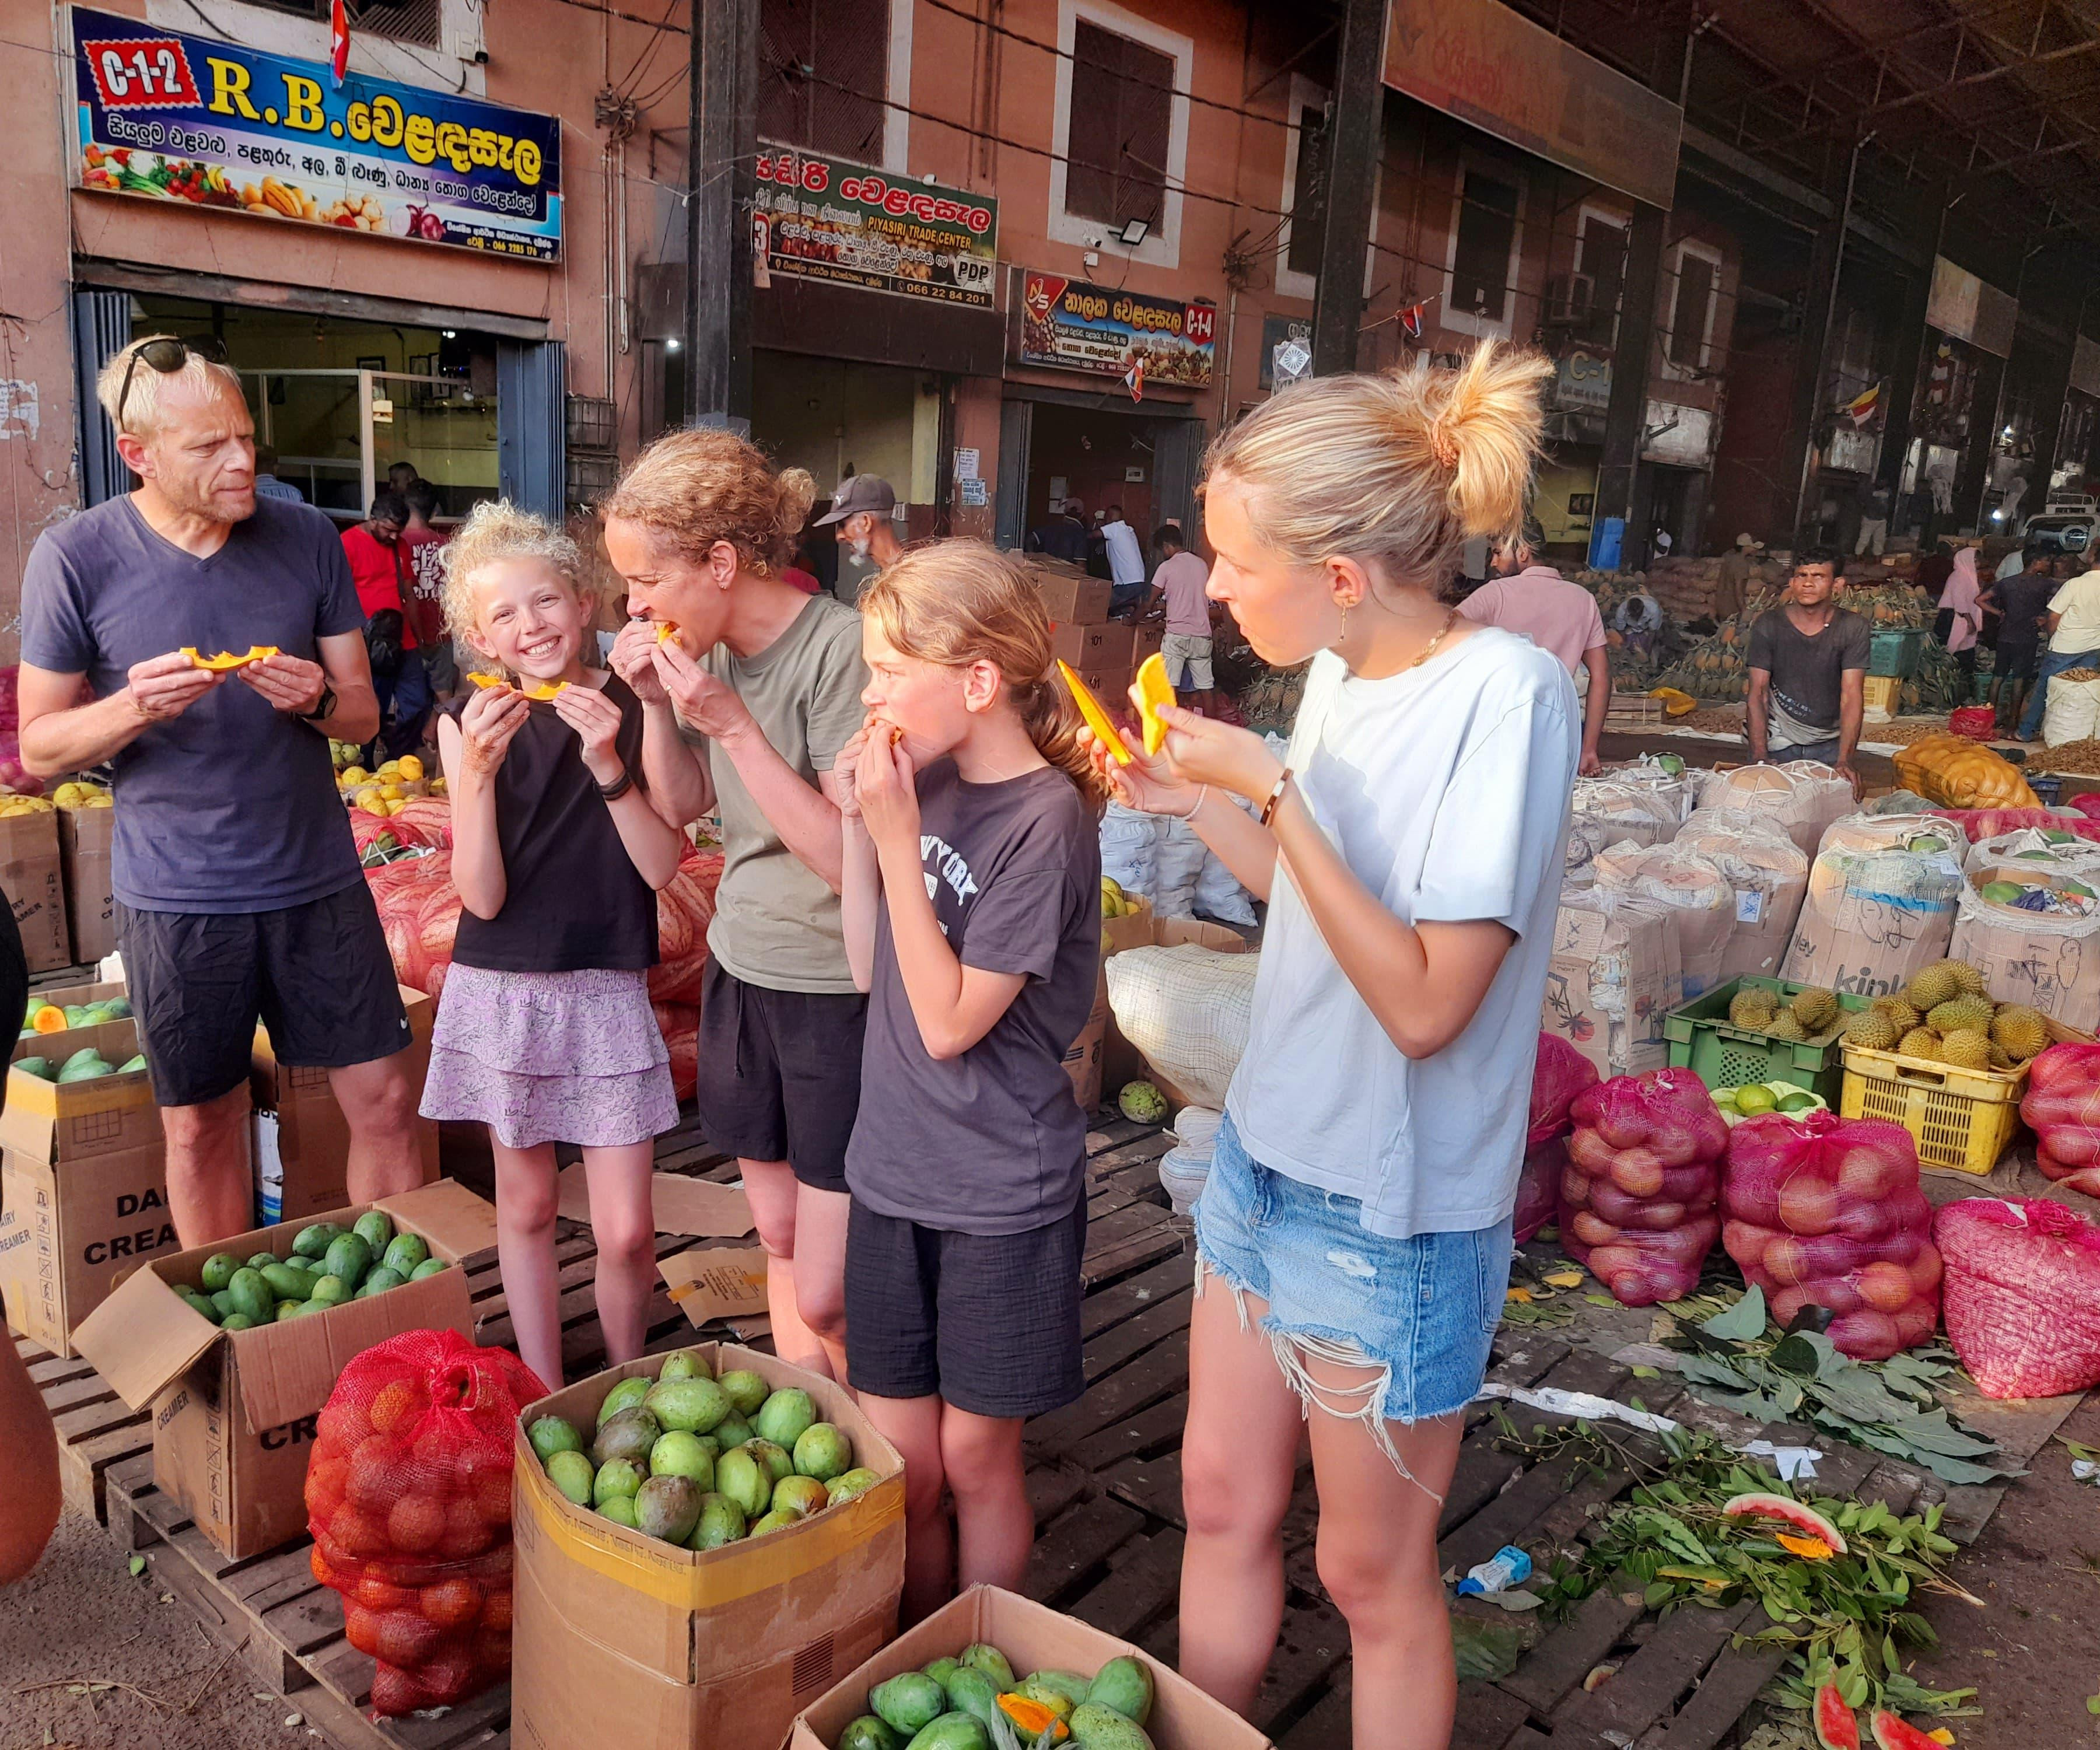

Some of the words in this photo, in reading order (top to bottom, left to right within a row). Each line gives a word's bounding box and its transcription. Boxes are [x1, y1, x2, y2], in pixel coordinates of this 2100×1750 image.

[101, 49, 182, 96] C-1-2
[109, 114, 164, 146] සියලුම
[435, 181, 468, 199] තොග
[492, 241, 506, 251] 066
[527, 246, 537, 256] 176
[867, 216, 907, 237] PIYASIRI
[909, 225, 937, 242] TRADE
[938, 232, 972, 250] CENTER
[957, 261, 989, 283] PDP
[907, 283, 928, 295] 066
[932, 287, 946, 298] 22
[949, 290, 963, 300] 84
[965, 293, 985, 304] 201
[1186, 307, 1212, 338] C-1-4
[1091, 635, 1102, 647] 101
[936, 839, 979, 907] YORK
[0, 1209, 16, 1228] AIRY
[0, 1229, 32, 1254] REAMER
[84, 1223, 178, 1265] CREA
[158, 1390, 190, 1431] CREAMER
[260, 1414, 318, 1451] CR
